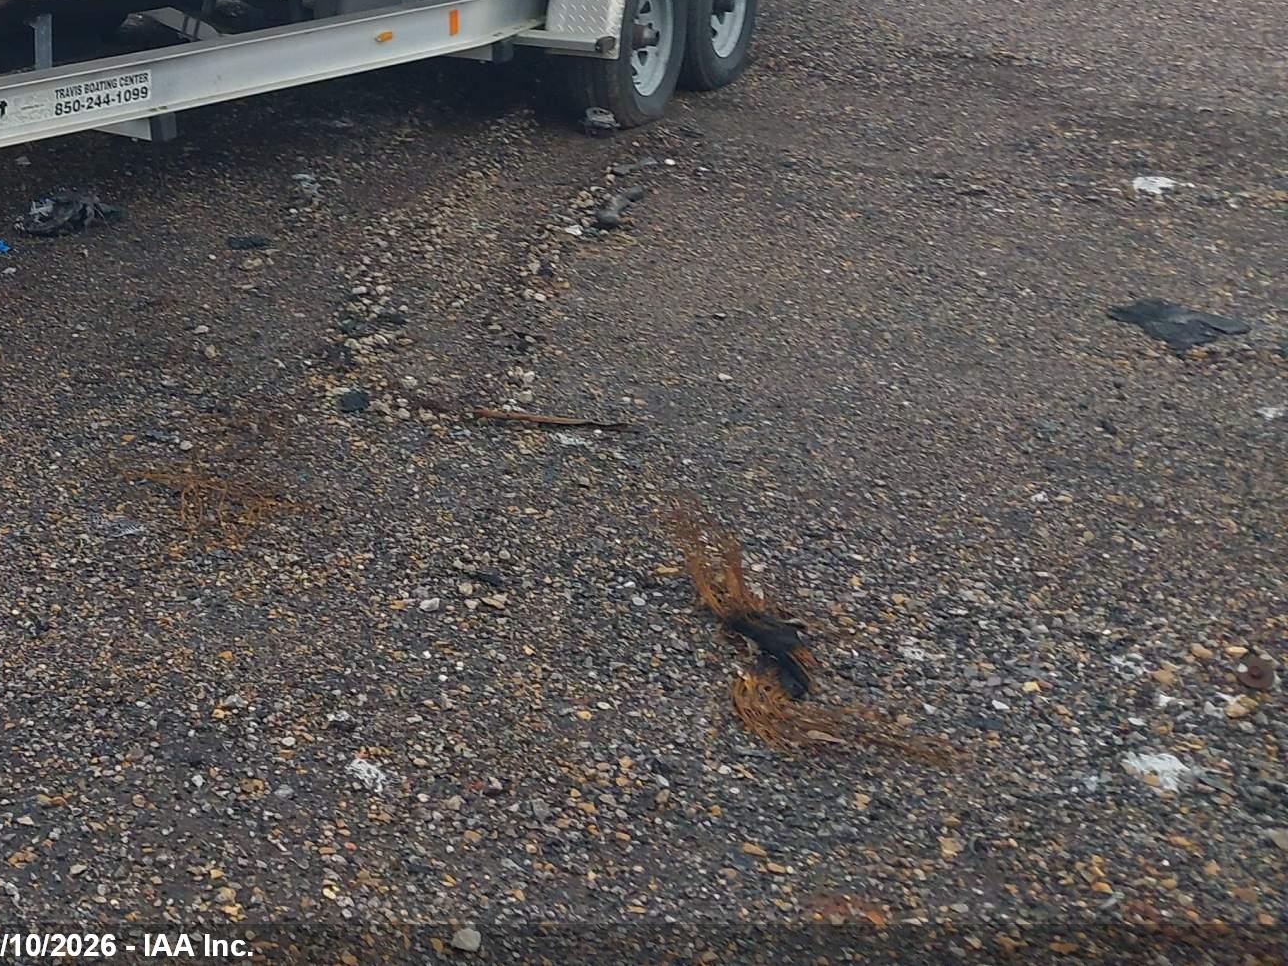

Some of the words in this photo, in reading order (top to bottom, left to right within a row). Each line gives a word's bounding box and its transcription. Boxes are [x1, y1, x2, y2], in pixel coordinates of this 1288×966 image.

[55, 85, 83, 99] TRAVIS
[84, 78, 118, 94] BOATING
[119, 73, 149, 88] CENTER
[55, 86, 148, 115] 850-244-1099
